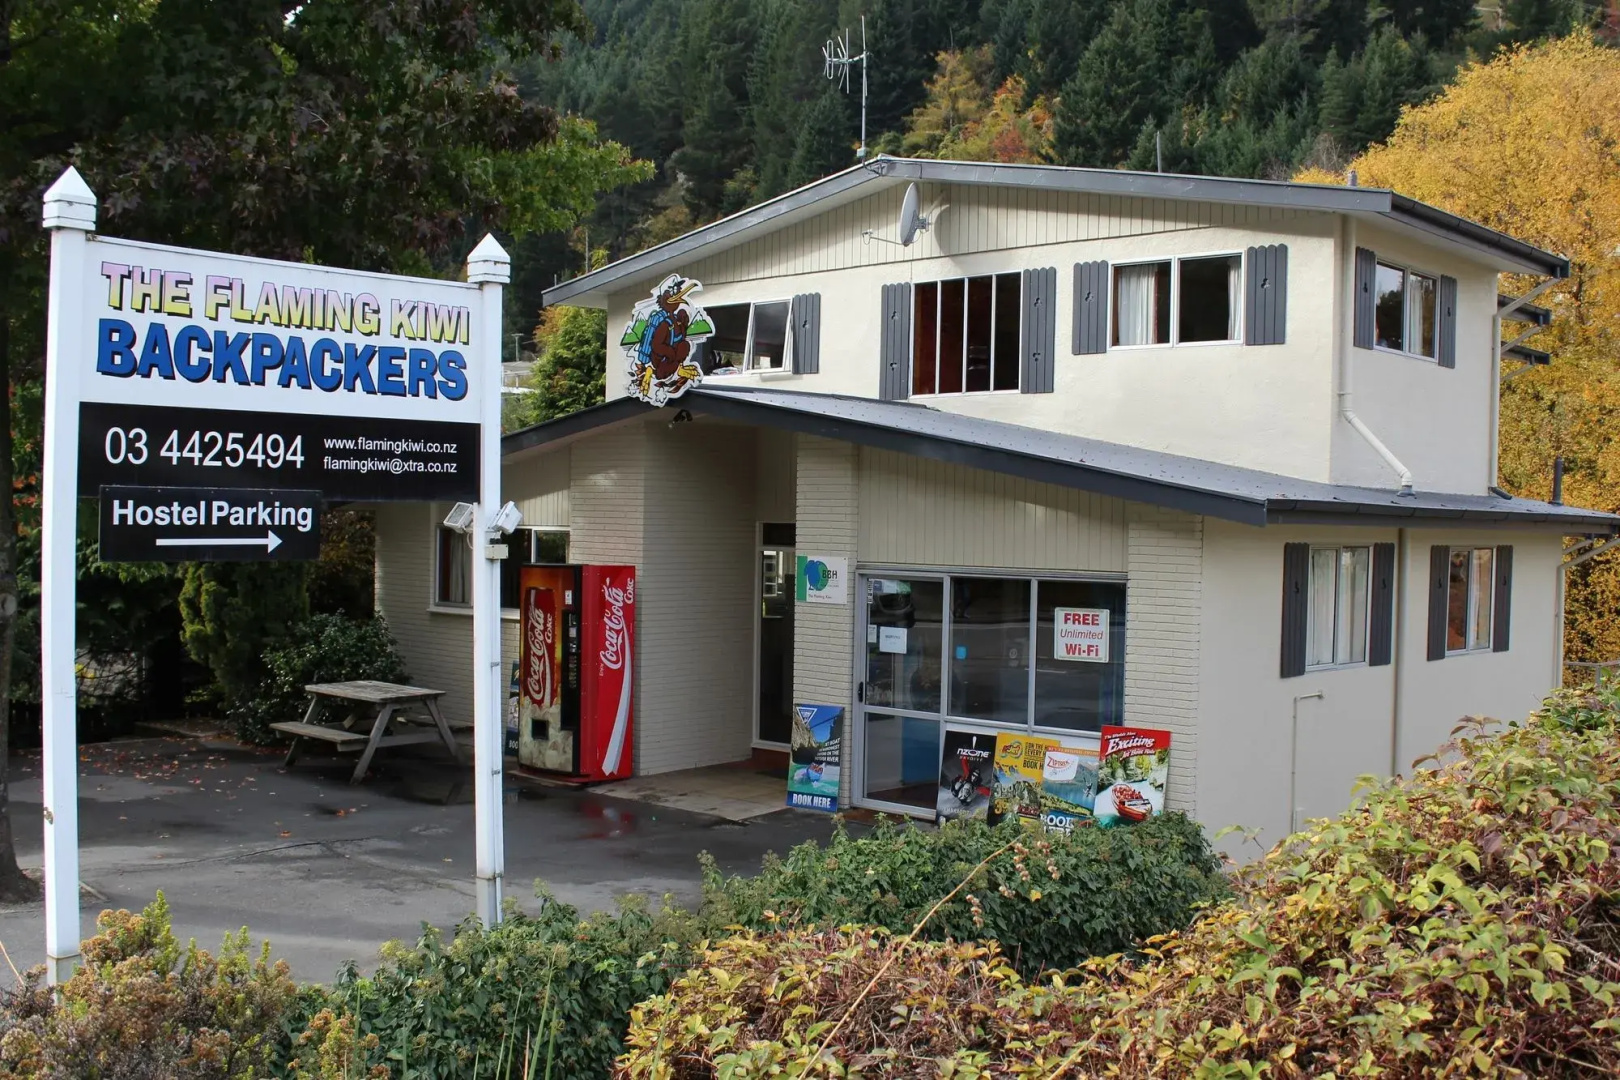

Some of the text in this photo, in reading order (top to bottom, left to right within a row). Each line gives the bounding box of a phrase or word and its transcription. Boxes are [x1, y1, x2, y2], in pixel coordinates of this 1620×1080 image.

[101, 261, 470, 345] THE FLAMING KIWI
[97, 318, 469, 401] BACKPACKERS
[105, 426, 305, 469] 03 4425494
[323, 436, 457, 454] www.flamingkiwi.co.nz
[323, 456, 457, 475] flamingkiwi@xtra.co.nz
[112, 499, 313, 533] Hostel Parking
[822, 569, 838, 579] BBH
[624, 577, 634, 604] Coke
[545, 613, 553, 643] Coke
[600, 584, 624, 670] Coca-Cola
[1063, 612, 1100, 626] FREE
[1060, 629, 1104, 640] Unlimited
[528, 604, 545, 700] Coca-Cola
[1065, 643, 1099, 657] Wi-Fi
[508, 740, 518, 749] BOO
[1105, 735, 1155, 756] Exciting
[1022, 759, 1038, 770] BOOK
[792, 793, 831, 809] BOOK HERE
